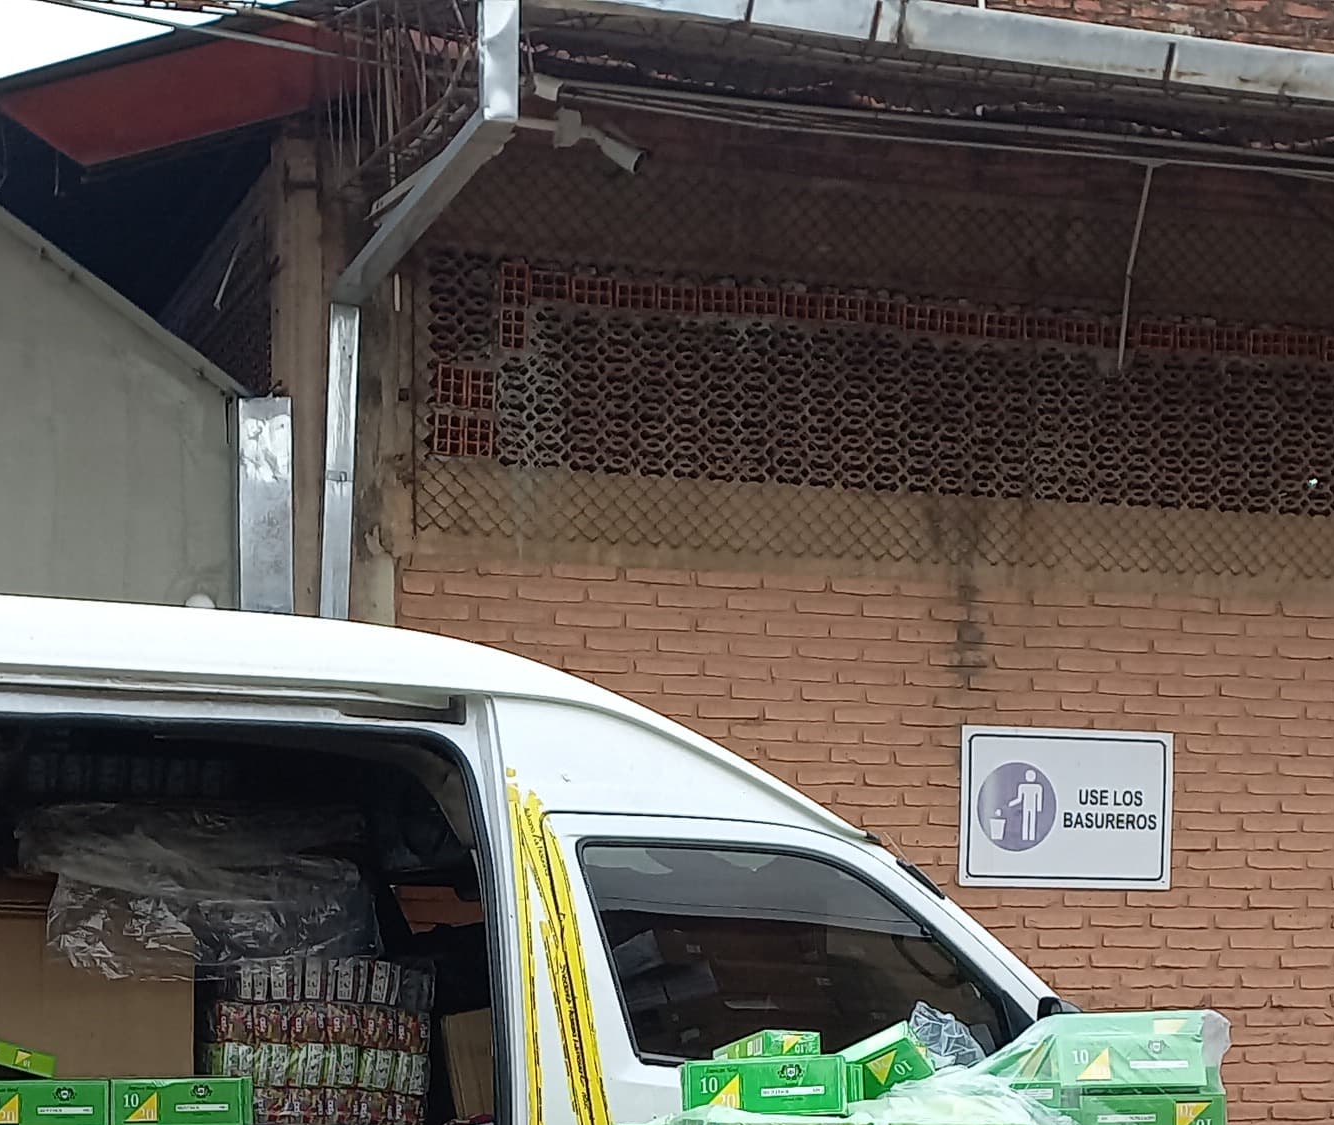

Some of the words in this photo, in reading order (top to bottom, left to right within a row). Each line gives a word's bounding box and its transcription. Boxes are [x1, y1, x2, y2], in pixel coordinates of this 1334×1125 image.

[1079, 789, 1109, 806] USE
[1113, 790, 1143, 807] LOS
[1063, 811, 1157, 831] BASUREROS
[1071, 1049, 1090, 1065] 10
[894, 1059, 913, 1076] 10
[700, 1076, 718, 1094] 10
[123, 1093, 139, 1108] 10
[0, 1110, 17, 1123] 20
[140, 1108, 156, 1121] 20
